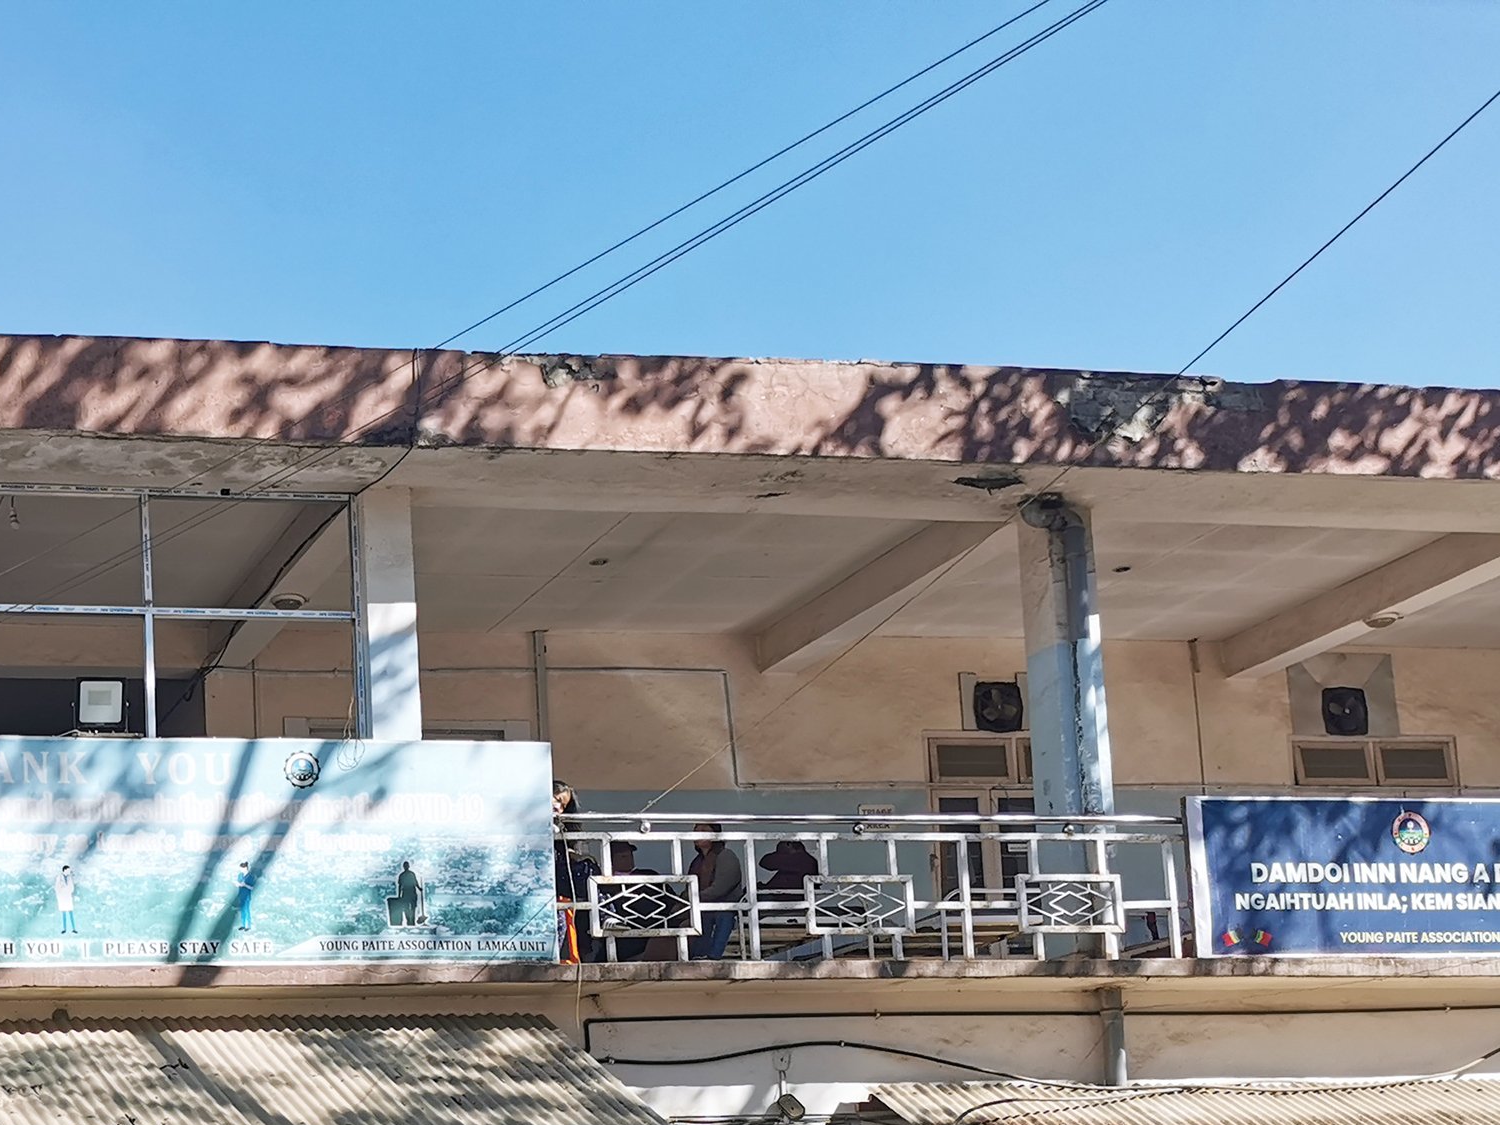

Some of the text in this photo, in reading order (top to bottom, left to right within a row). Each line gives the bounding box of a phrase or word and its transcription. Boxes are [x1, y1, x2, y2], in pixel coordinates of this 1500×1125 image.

[136, 750, 231, 785] YOU
[1252, 863, 1349, 883] DAMDOI
[1355, 863, 1396, 883] INN
[1400, 863, 1468, 883] NANG
[1473, 863, 1490, 883] A
[1236, 893, 1357, 910] NGAIHTUAH
[1358, 893, 1407, 913] INLA;
[1412, 893, 1453, 910] KEM
[320, 940, 547, 951] YOUNG PAITE ASSOCIATION LAMKA UNIT
[1340, 931, 1500, 943] YOUNG PAITE ASSOCIATION
[26, 942, 61, 955] YOU
[105, 942, 169, 954] PLEASE
[180, 942, 220, 954] STAY
[231, 941, 273, 954] SAFE
